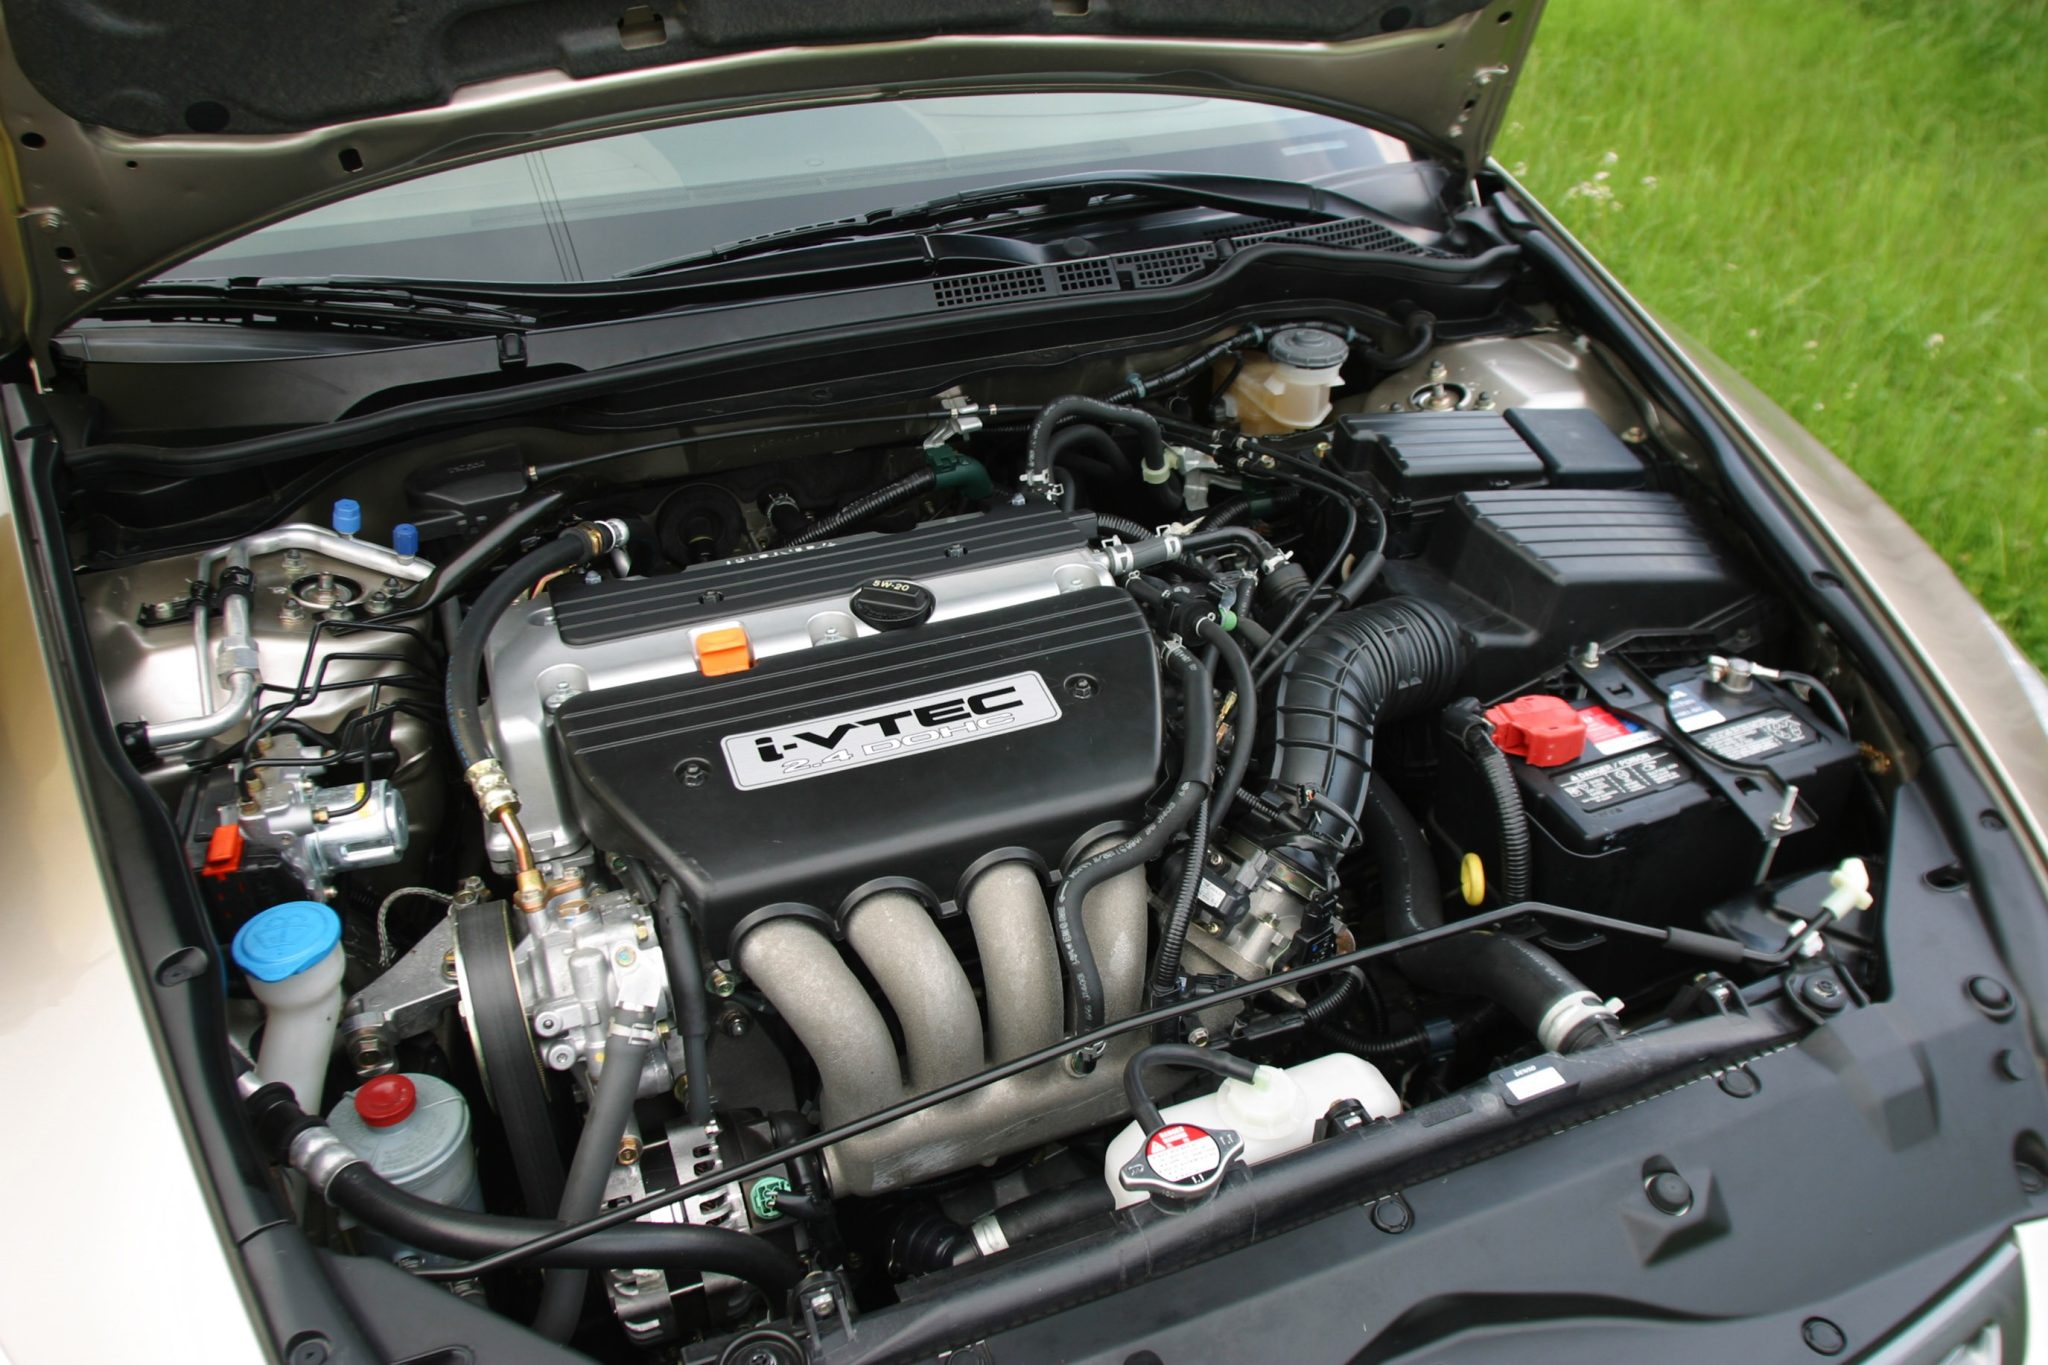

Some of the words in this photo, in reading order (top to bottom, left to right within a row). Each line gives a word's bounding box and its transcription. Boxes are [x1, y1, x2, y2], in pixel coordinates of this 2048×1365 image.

[872, 579, 910, 592] 5W-20
[755, 686, 1024, 763] i-VTEC
[781, 749, 854, 775] 2.4
[862, 712, 1016, 757] DOHC
[1191, 1172, 1205, 1185] 1.1
